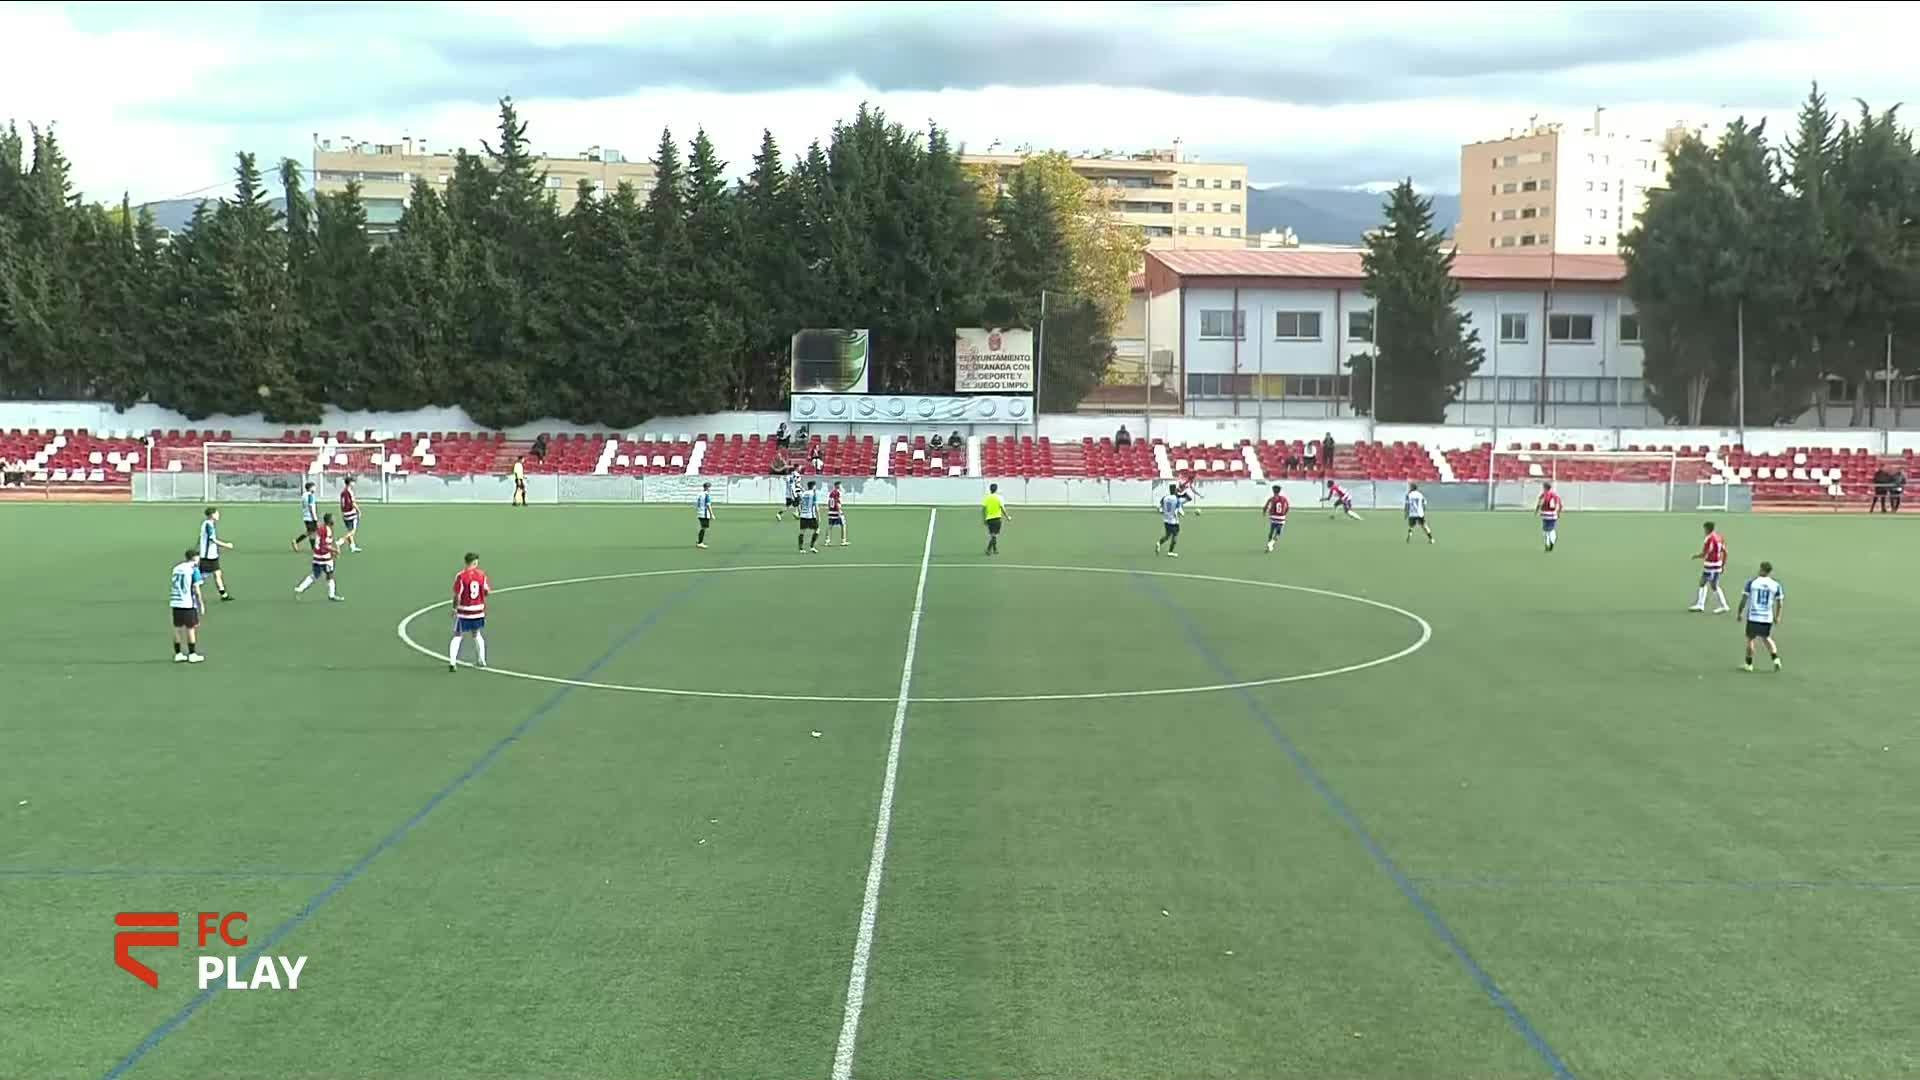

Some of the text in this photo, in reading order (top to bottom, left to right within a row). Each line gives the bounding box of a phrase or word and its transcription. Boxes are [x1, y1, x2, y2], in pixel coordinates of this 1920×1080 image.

[971, 354, 1031, 362] AYUNTAMIENTO
[973, 363, 1012, 371] GRANADA
[1012, 363, 1030, 371] CON
[978, 372, 1015, 380] DEPORTE
[1016, 372, 1023, 380] Y
[975, 381, 1001, 389] JUEGO
[1002, 381, 1029, 389] LIMPIO
[470, 580, 480, 600] 9
[1757, 588, 1770, 605] 19
